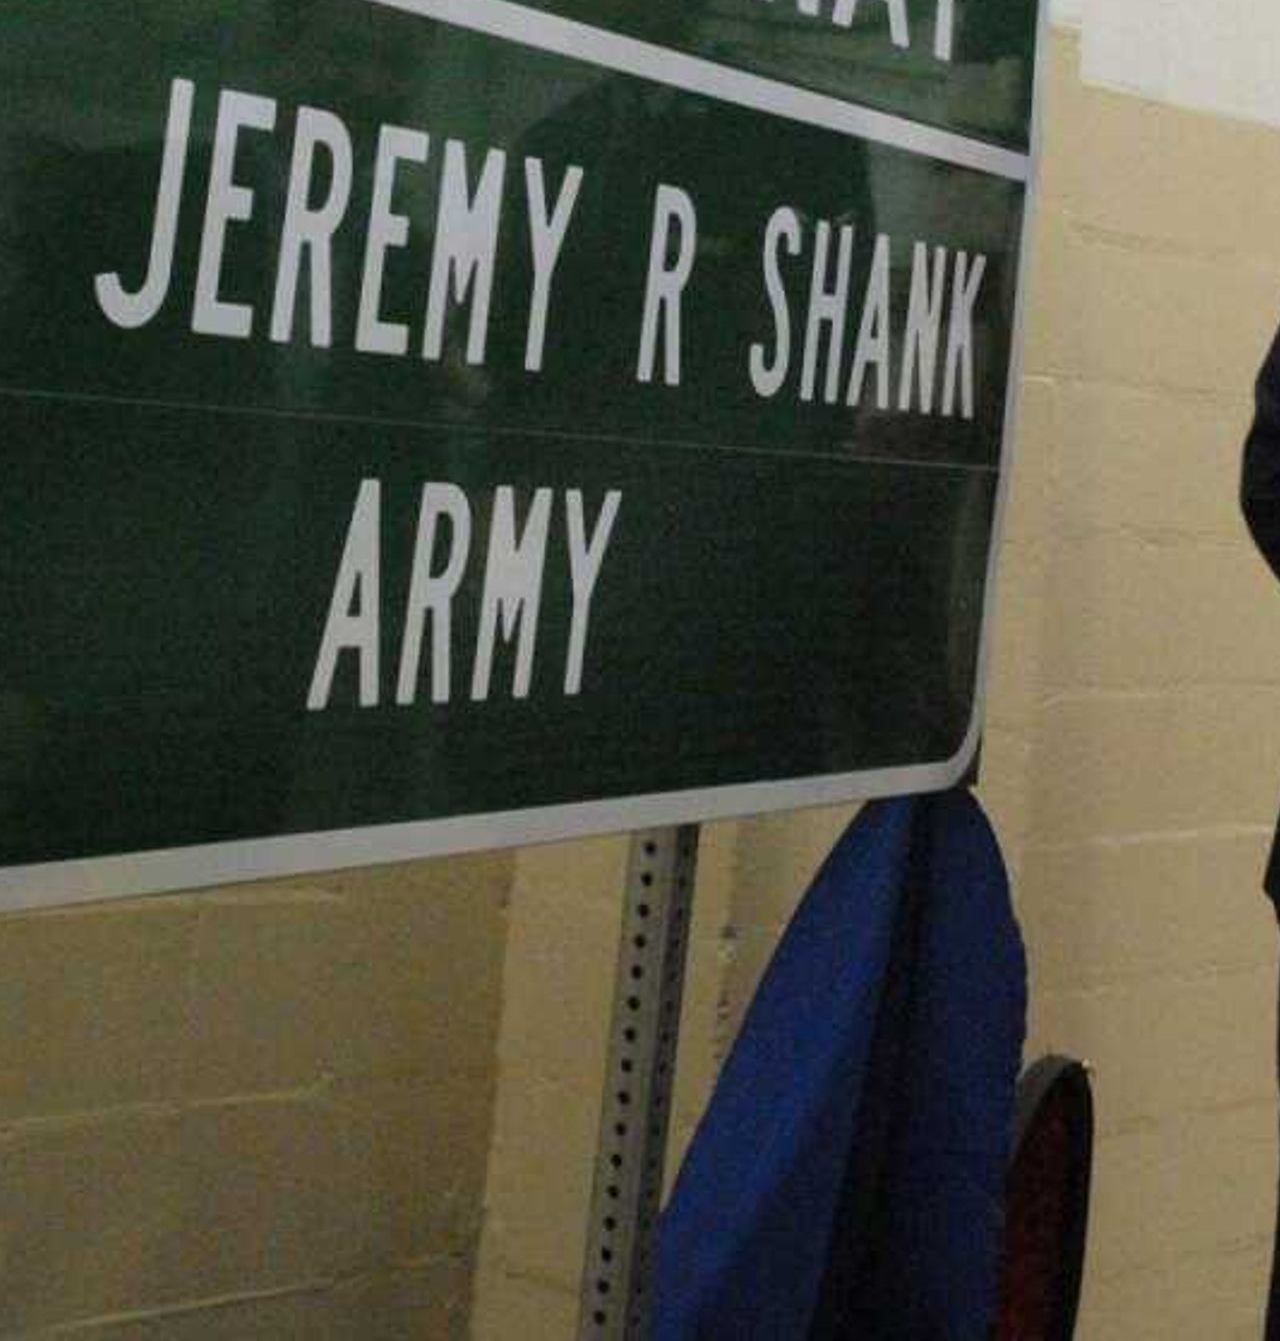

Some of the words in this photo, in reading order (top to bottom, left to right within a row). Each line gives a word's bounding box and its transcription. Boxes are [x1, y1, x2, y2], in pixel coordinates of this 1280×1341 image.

[95, 77, 584, 372] JEREMY
[637, 184, 696, 385] R
[749, 206, 986, 418] SHANK
[306, 479, 622, 711] ARMY
